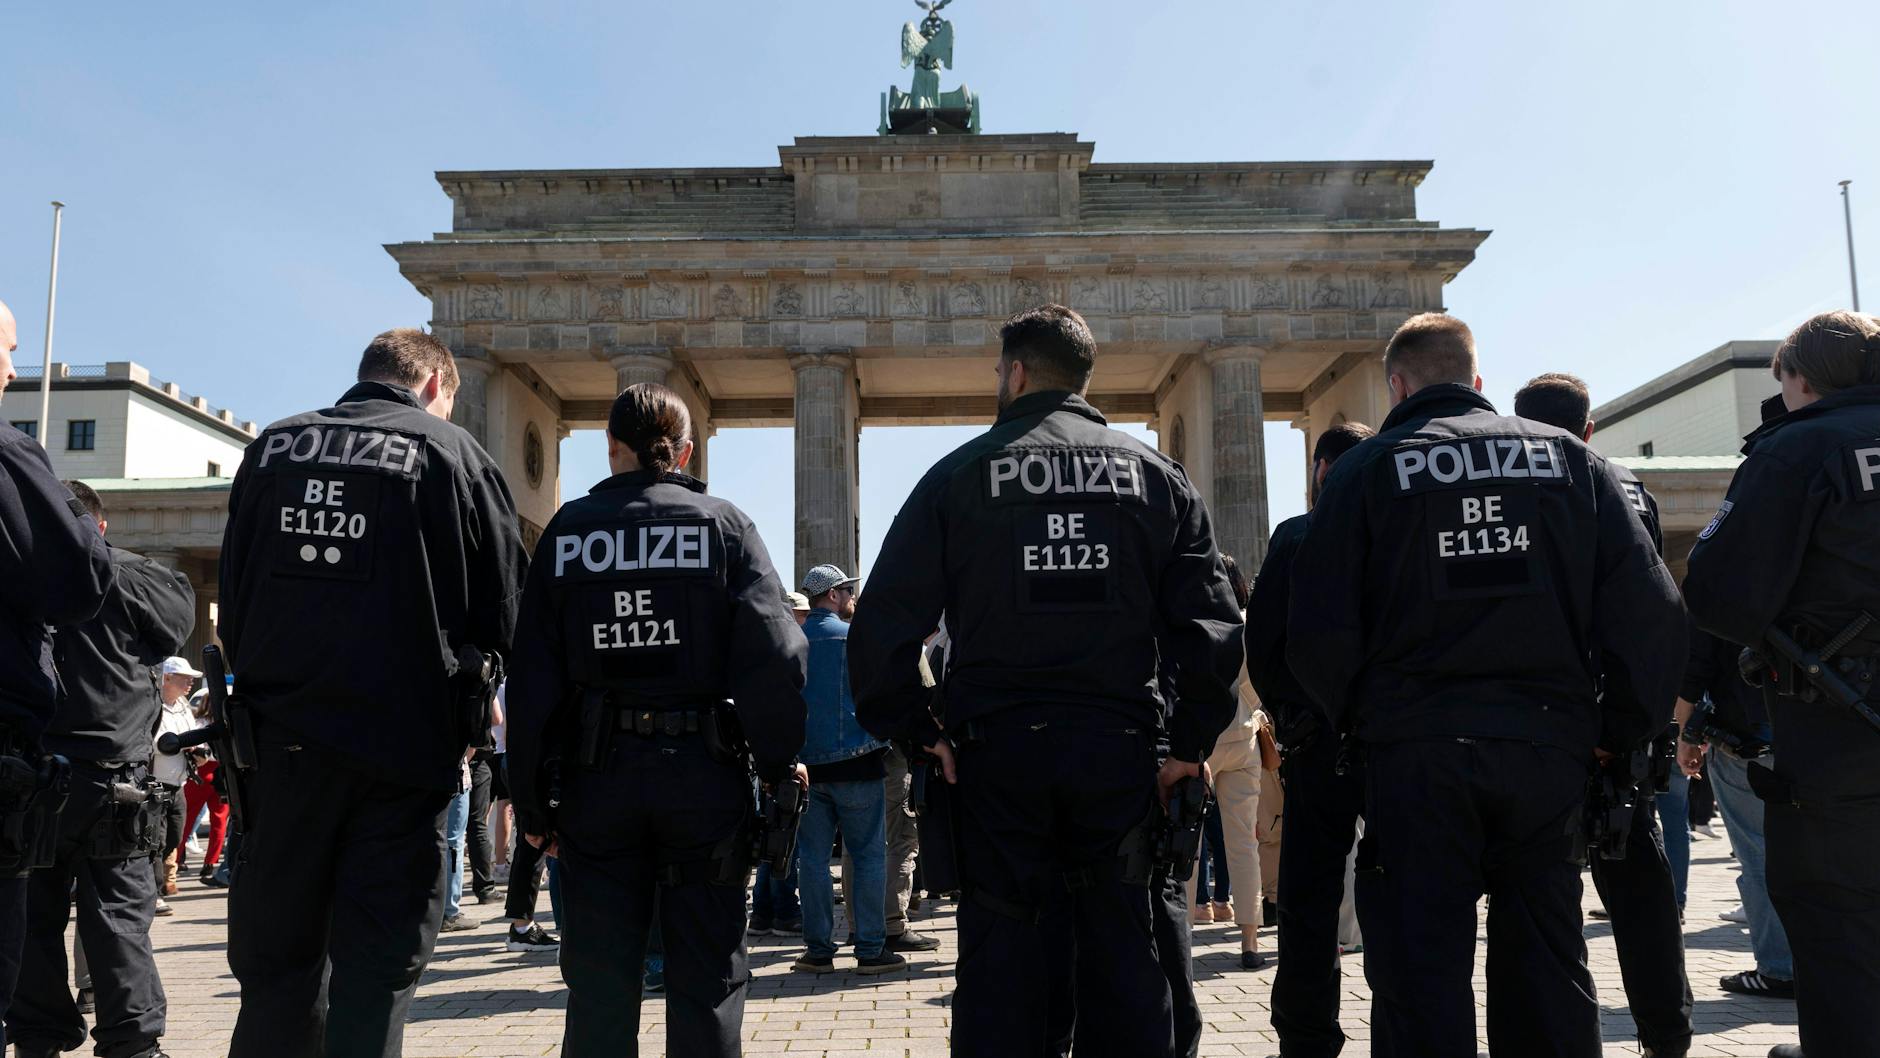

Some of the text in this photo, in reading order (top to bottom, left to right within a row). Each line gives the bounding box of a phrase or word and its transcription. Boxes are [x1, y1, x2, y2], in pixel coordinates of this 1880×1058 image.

[258, 426, 419, 473] POLIZEI
[1394, 439, 1563, 491] POLIZEI
[990, 454, 1141, 498] POLIZEI
[304, 479, 345, 506] BE
[280, 506, 366, 539] E1120
[1462, 495, 1503, 524] BE
[1047, 513, 1085, 539] BE
[1438, 525, 1530, 557] E1134
[555, 525, 709, 577] POLIZEI
[1023, 543, 1110, 571] E1123
[614, 589, 653, 617] BE
[592, 619, 680, 649] E1121
